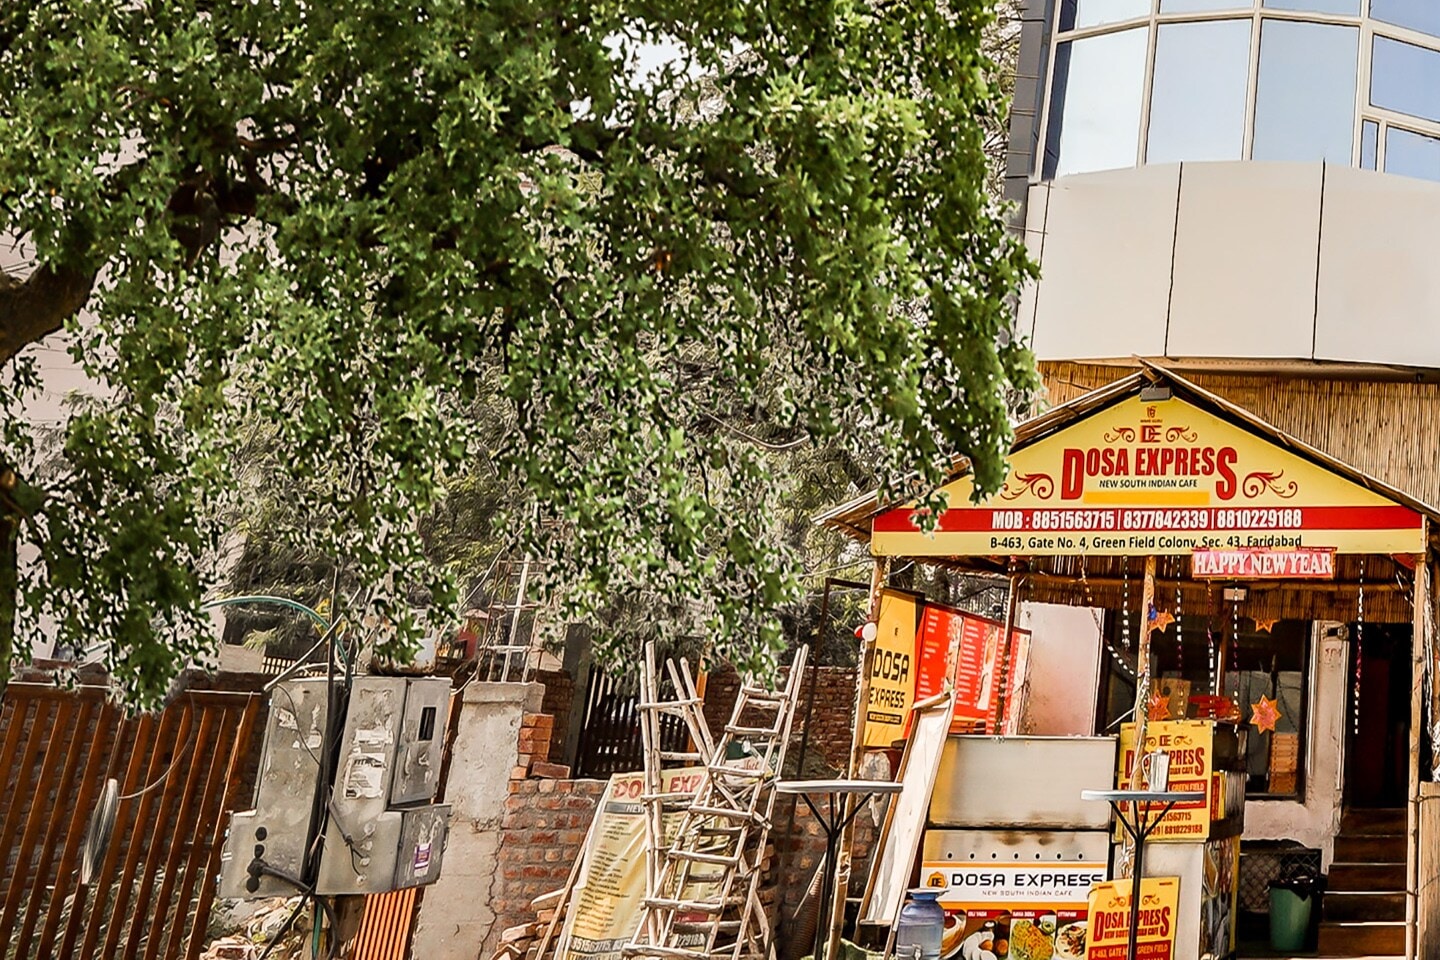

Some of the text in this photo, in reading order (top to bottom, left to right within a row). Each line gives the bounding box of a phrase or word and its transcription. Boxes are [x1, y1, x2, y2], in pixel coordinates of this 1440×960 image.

[1060, 446, 1238, 501] DOSA EXPRESS
[1099, 479, 1197, 488] NEW SOUTH INDIAN CAFE
[990, 537, 1025, 550] B-463,
[1028, 537, 1054, 548] Gate
[1057, 537, 1077, 548] No.
[1092, 536, 1126, 548] Green
[1129, 536, 1155, 548] Field
[1202, 536, 1223, 548] Sec.
[1247, 535, 1302, 548] Faridabad
[1194, 551, 1244, 575] HAPPY
[872, 648, 910, 685] DOSA
[869, 687, 905, 708] EXPRESS
[952, 874, 1104, 888] DOSA EXPRESS
[1093, 906, 1170, 942] DOSA EPRESS
